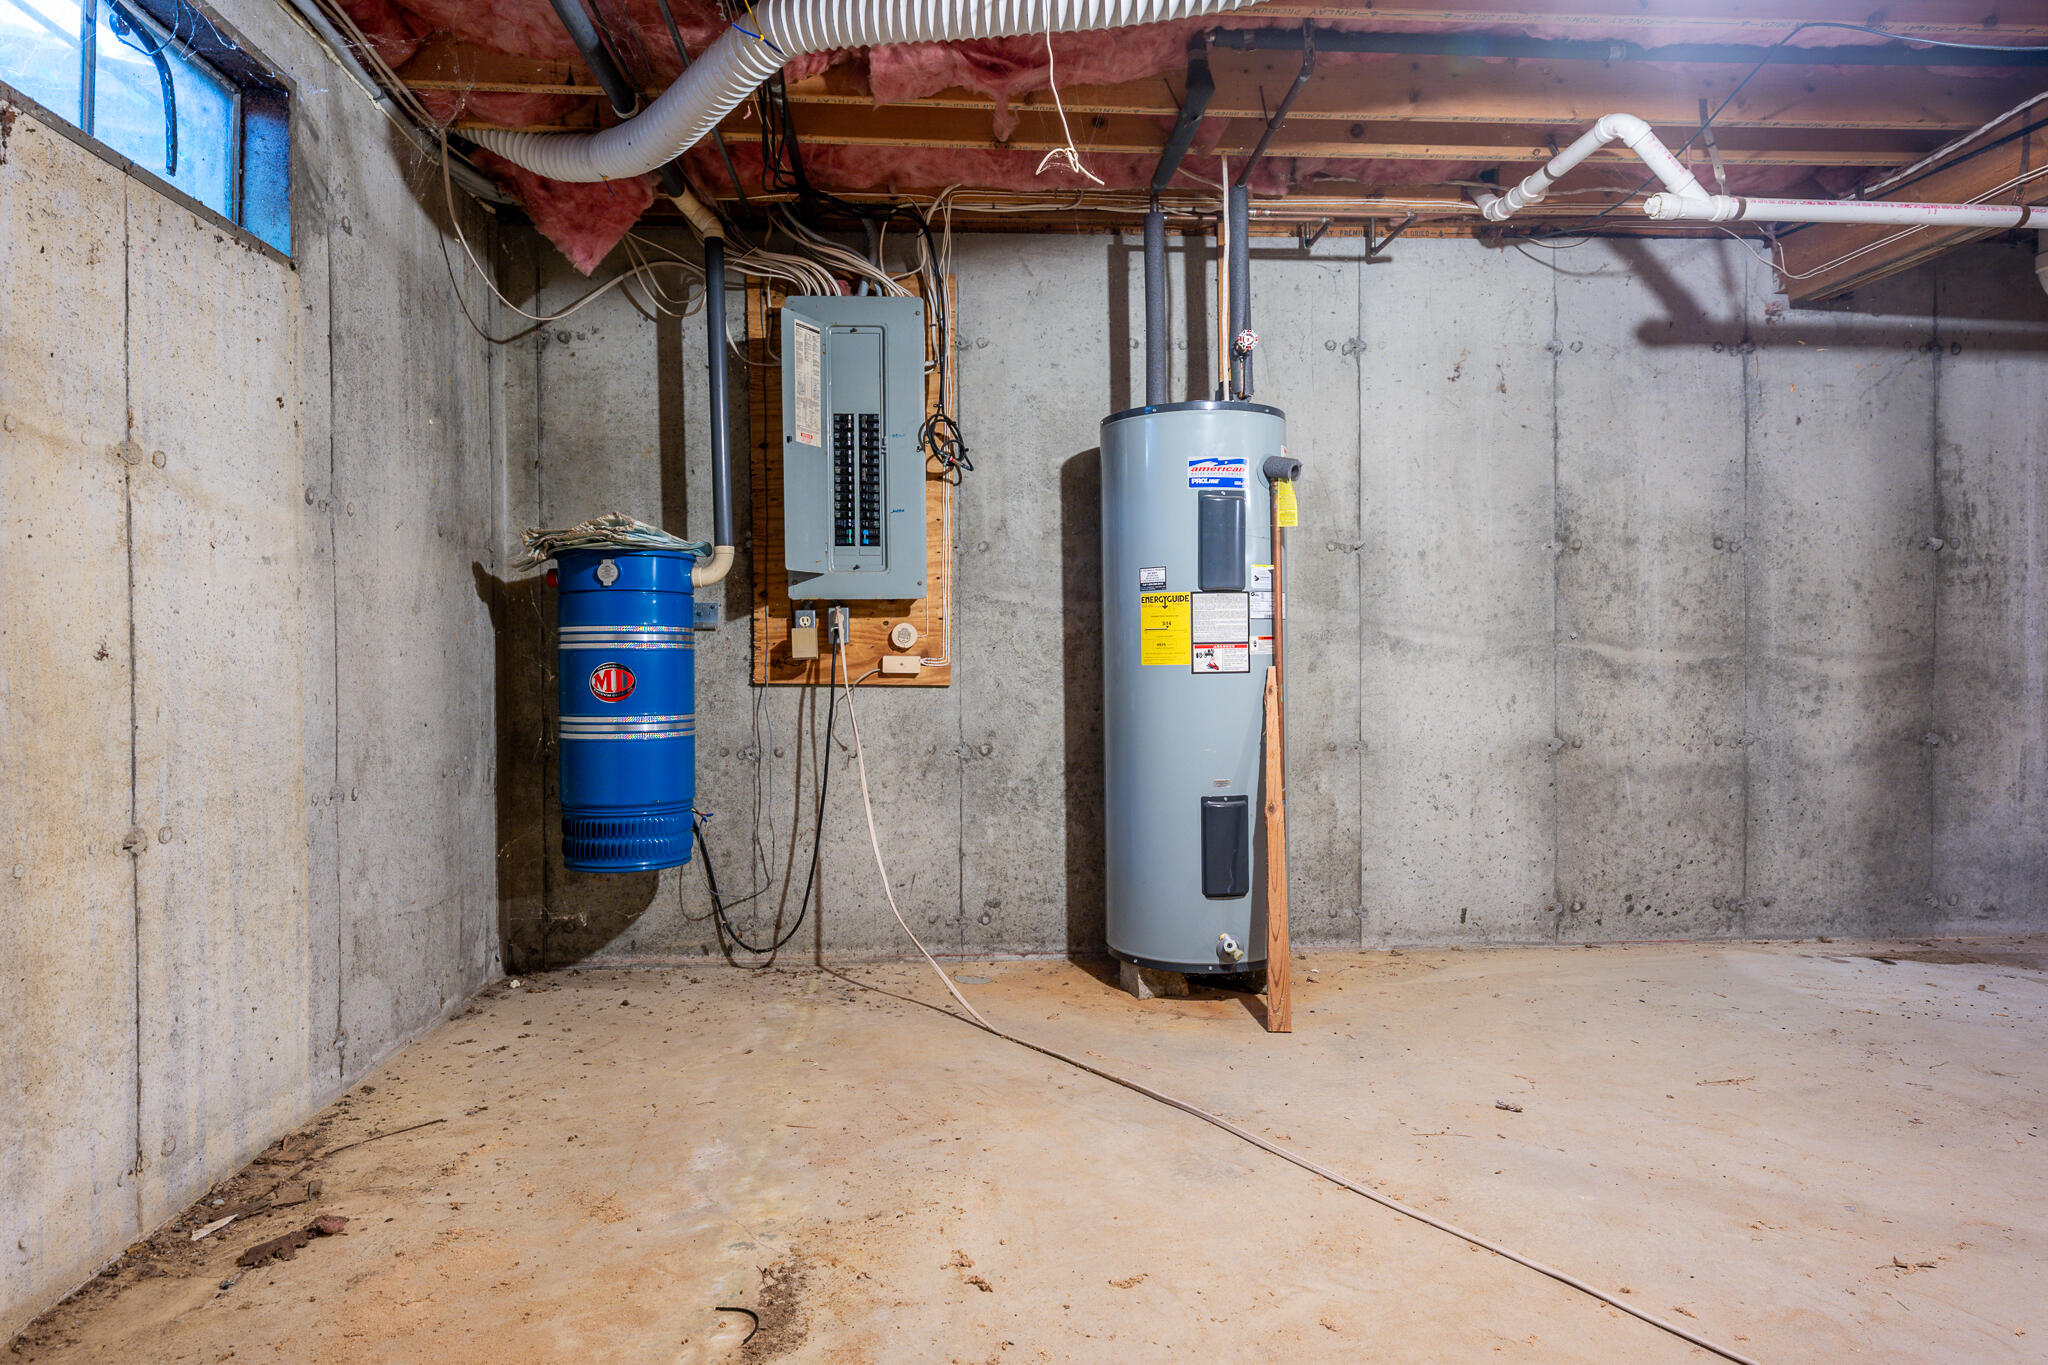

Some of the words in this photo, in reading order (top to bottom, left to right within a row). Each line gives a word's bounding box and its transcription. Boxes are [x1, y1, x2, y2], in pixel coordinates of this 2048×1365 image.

[1309, 8, 1359, 17] FINLAY
[815, 98, 858, 106] FINLAY
[1190, 465, 1246, 473] american
[1141, 594, 1190, 604] ENERGYGUIDE
